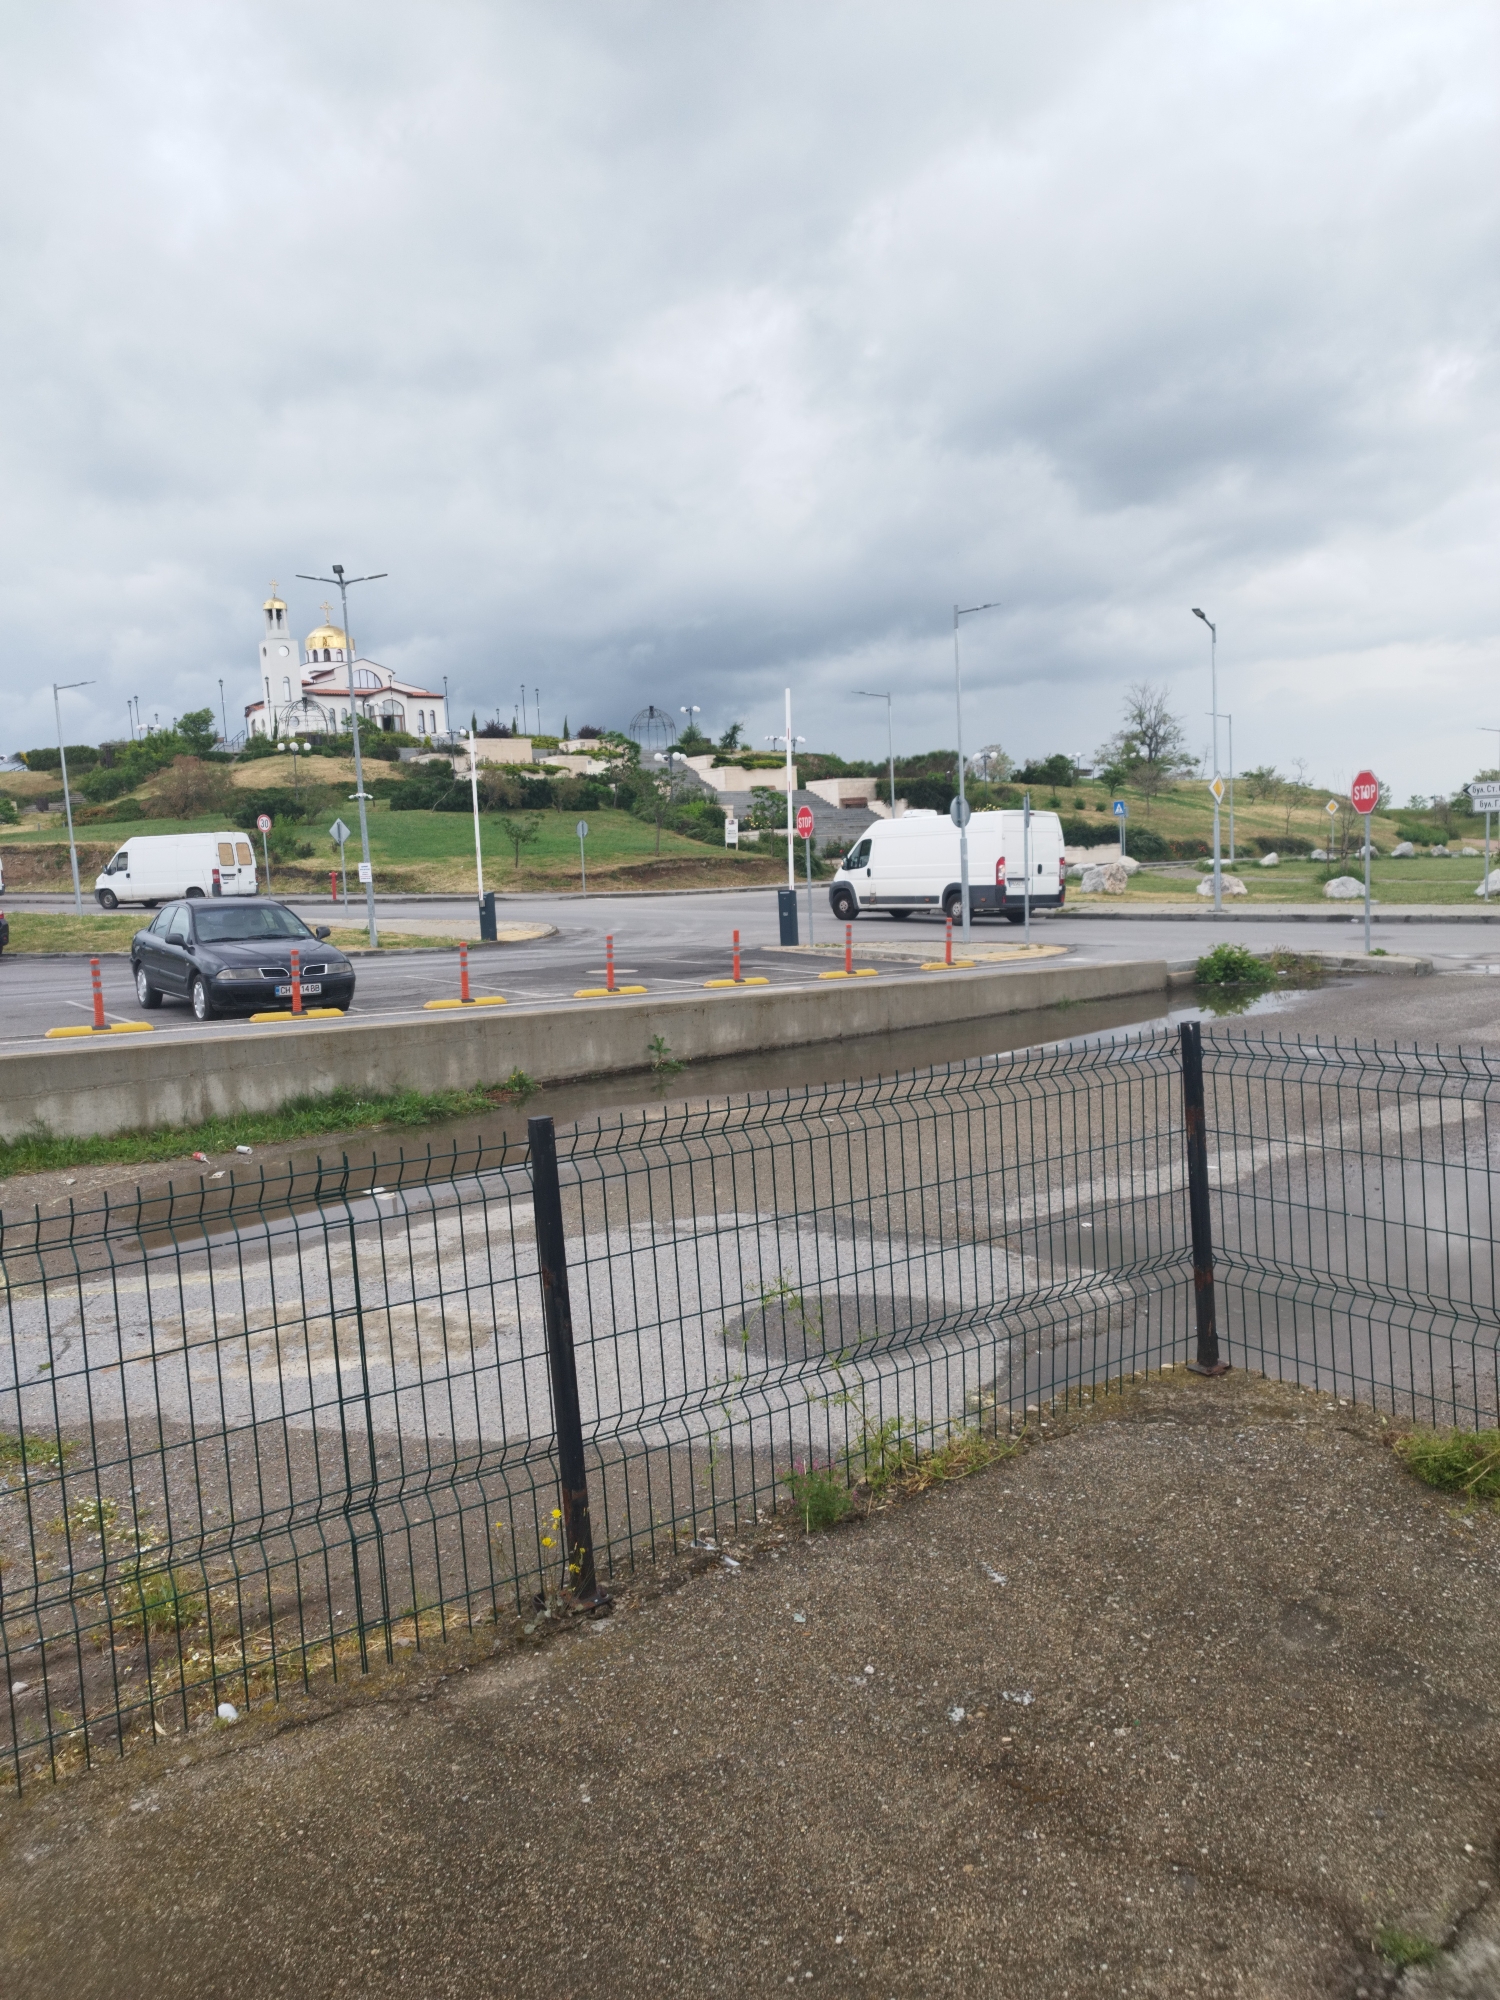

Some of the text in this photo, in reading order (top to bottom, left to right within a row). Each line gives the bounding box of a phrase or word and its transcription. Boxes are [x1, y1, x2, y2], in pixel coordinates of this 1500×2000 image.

[1354, 784, 1376, 800] STOP
[260, 818, 269, 829] 30
[798, 816, 812, 829] STOP
